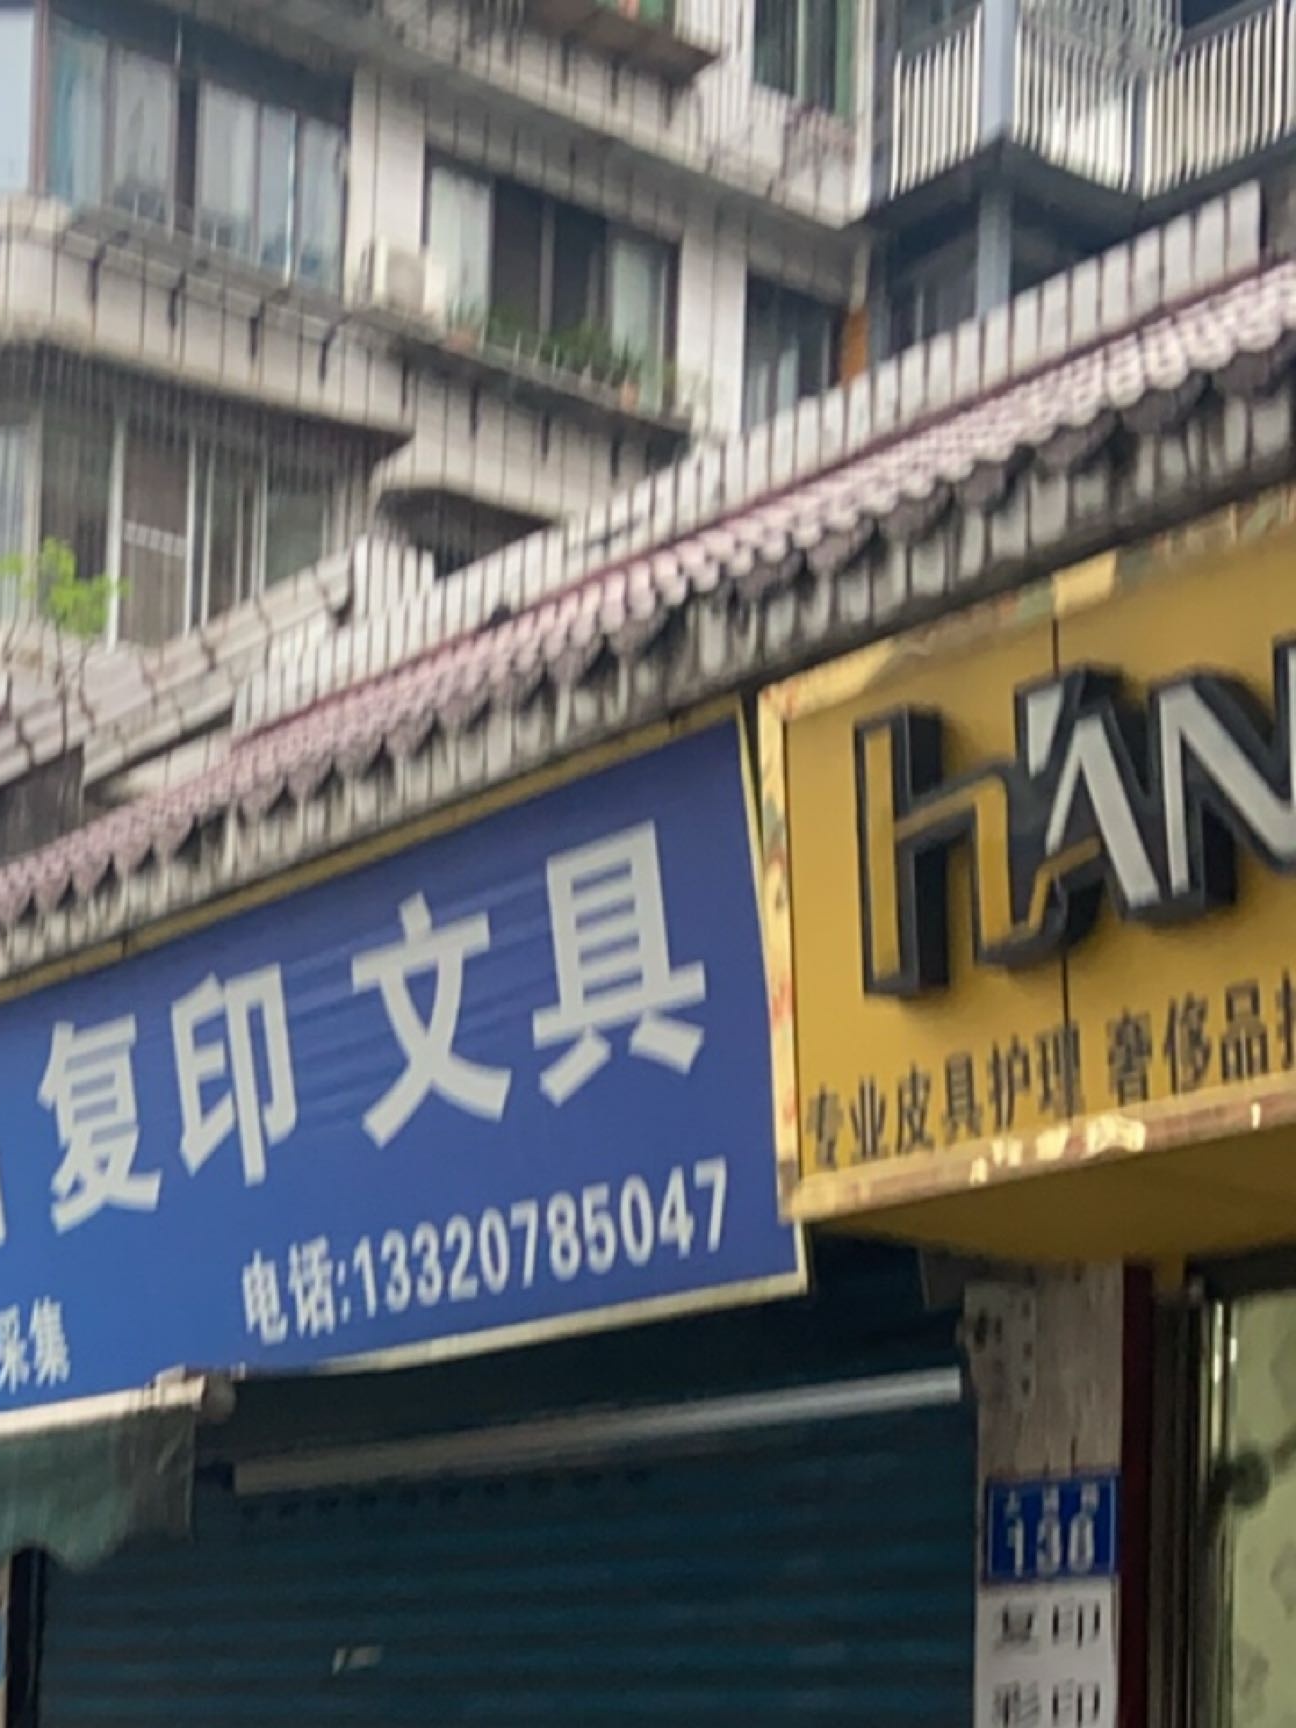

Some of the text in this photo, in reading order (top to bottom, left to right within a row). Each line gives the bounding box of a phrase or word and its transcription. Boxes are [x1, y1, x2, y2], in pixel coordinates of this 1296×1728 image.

[36, 960, 299, 1234] 复印
[351, 819, 707, 1149] 文具
[807, 1018, 1083, 1171] 专业皮具护理
[240, 1156, 729, 1347] 电话:13320785047
